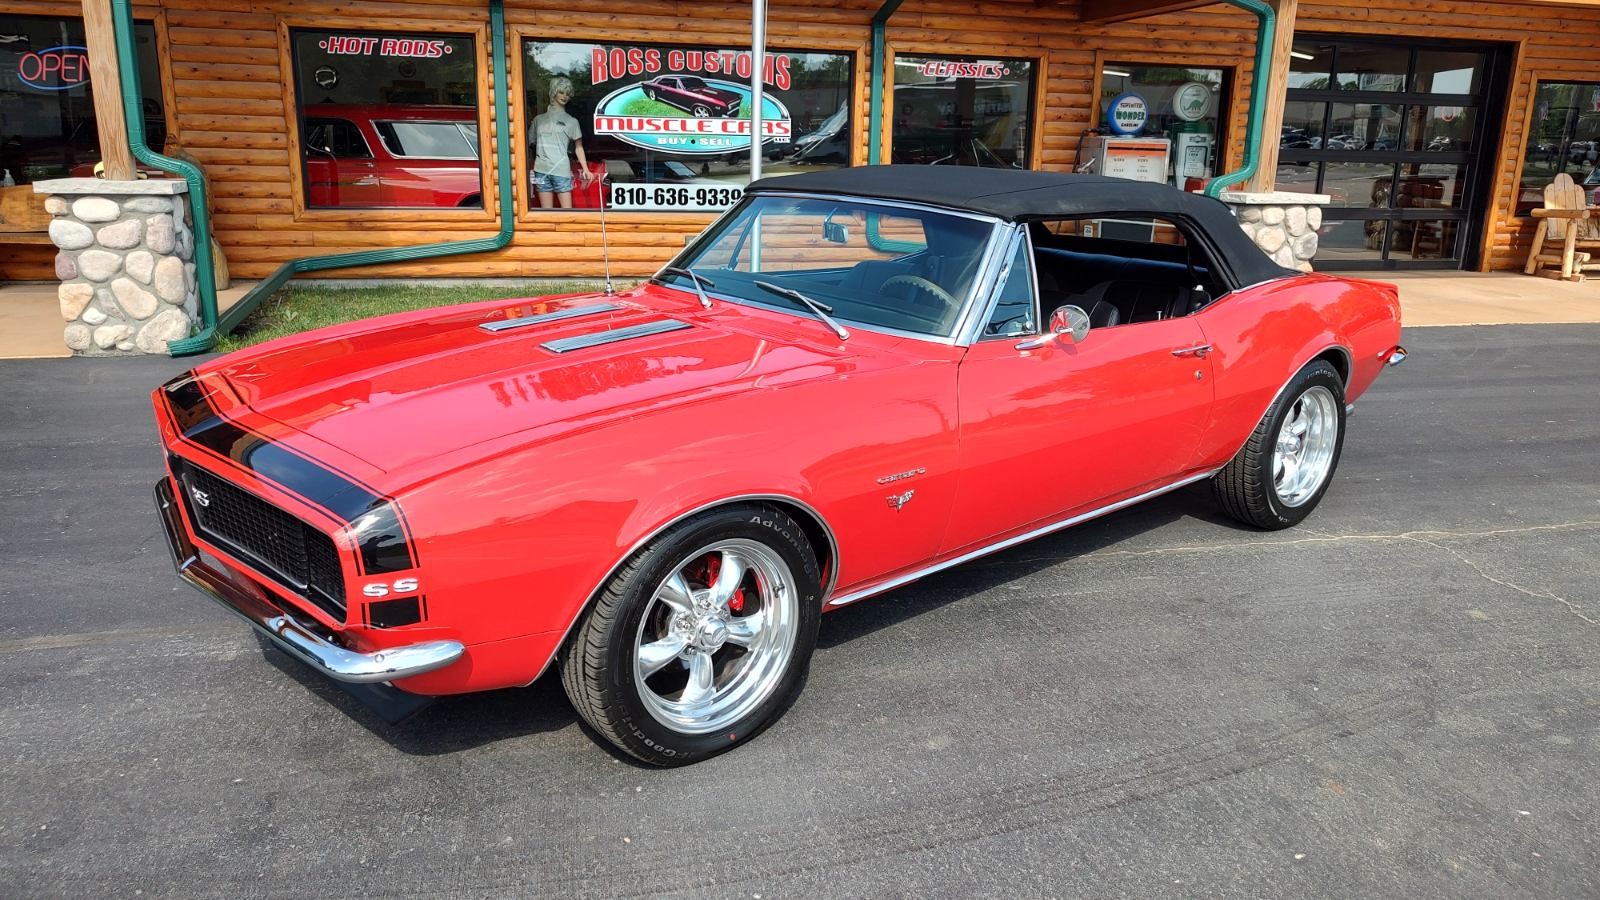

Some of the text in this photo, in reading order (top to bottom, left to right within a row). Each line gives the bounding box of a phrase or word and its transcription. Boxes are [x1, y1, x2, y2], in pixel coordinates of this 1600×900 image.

[327, 36, 445, 58] HOT RODS
[19, 52, 91, 82] OPEN
[591, 47, 661, 85] ROSS
[923, 61, 1004, 79] CLASSICS
[1115, 110, 1145, 120] WONDER
[595, 117, 790, 135] MUSCLE CARS
[657, 137, 732, 147] BUY SELL
[614, 187, 742, 206] 810-636-9339
[363, 577, 418, 597] SS
